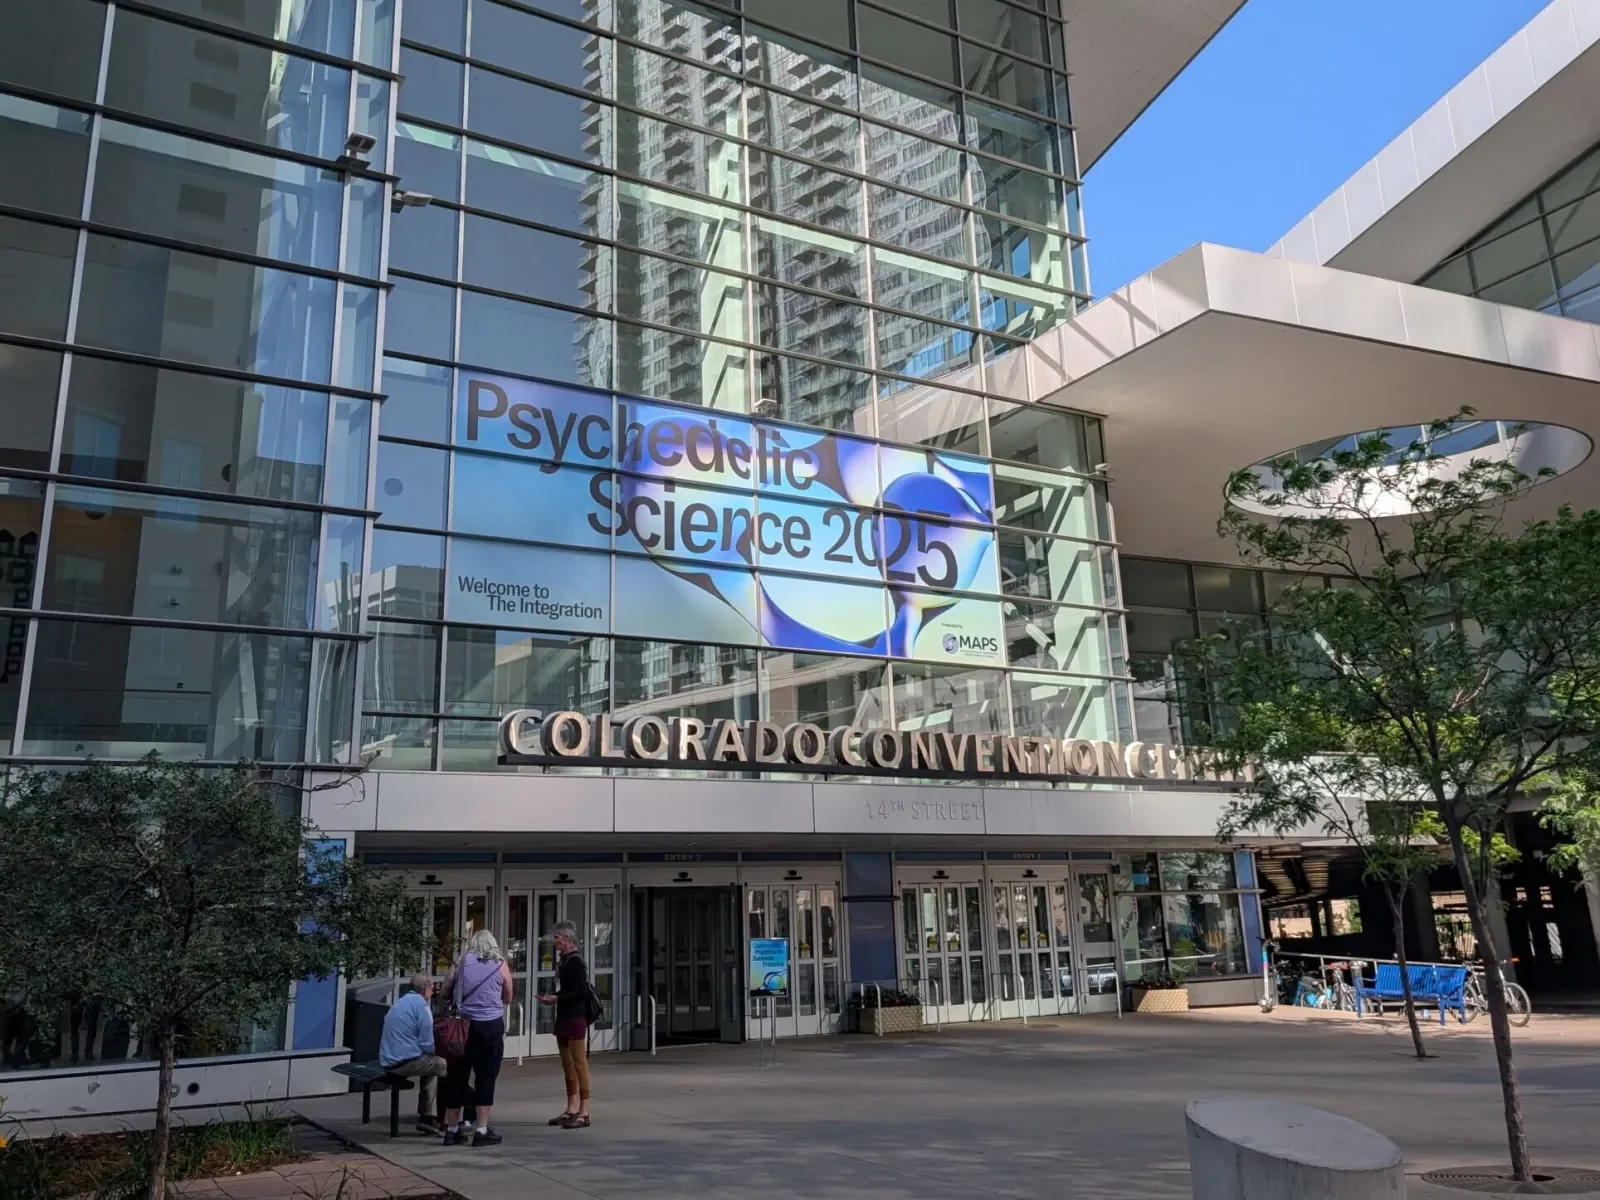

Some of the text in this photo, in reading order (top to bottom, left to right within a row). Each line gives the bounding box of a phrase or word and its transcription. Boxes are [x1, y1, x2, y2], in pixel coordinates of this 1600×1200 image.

[466, 379, 813, 490] Psychedelic
[587, 472, 958, 591] Science 2025
[458, 575, 550, 600] Welcome to
[487, 594, 603, 620] The Integration
[959, 635, 998, 652] MAPS
[499, 709, 826, 765] COLORADO
[828, 725, 1126, 778] CONVENTION
[866, 799, 984, 821] 14TH STREET
[664, 853, 693, 862] ENTRY
